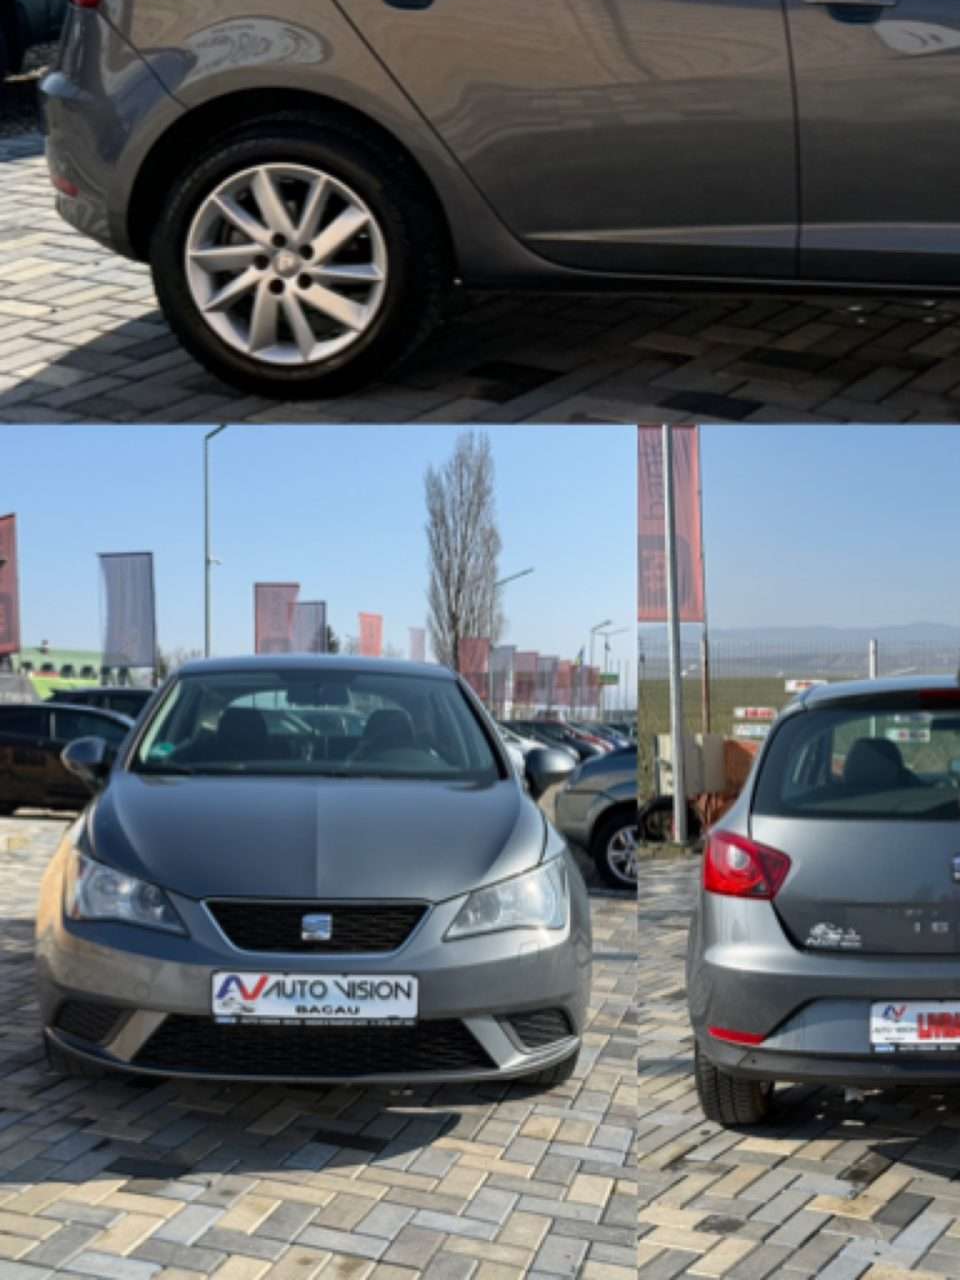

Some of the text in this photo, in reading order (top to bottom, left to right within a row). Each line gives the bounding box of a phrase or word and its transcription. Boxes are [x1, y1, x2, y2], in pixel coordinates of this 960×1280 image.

[262, 979, 329, 999] AUTO
[334, 979, 412, 1000] VISION
[294, 1004, 361, 1015] BACAU
